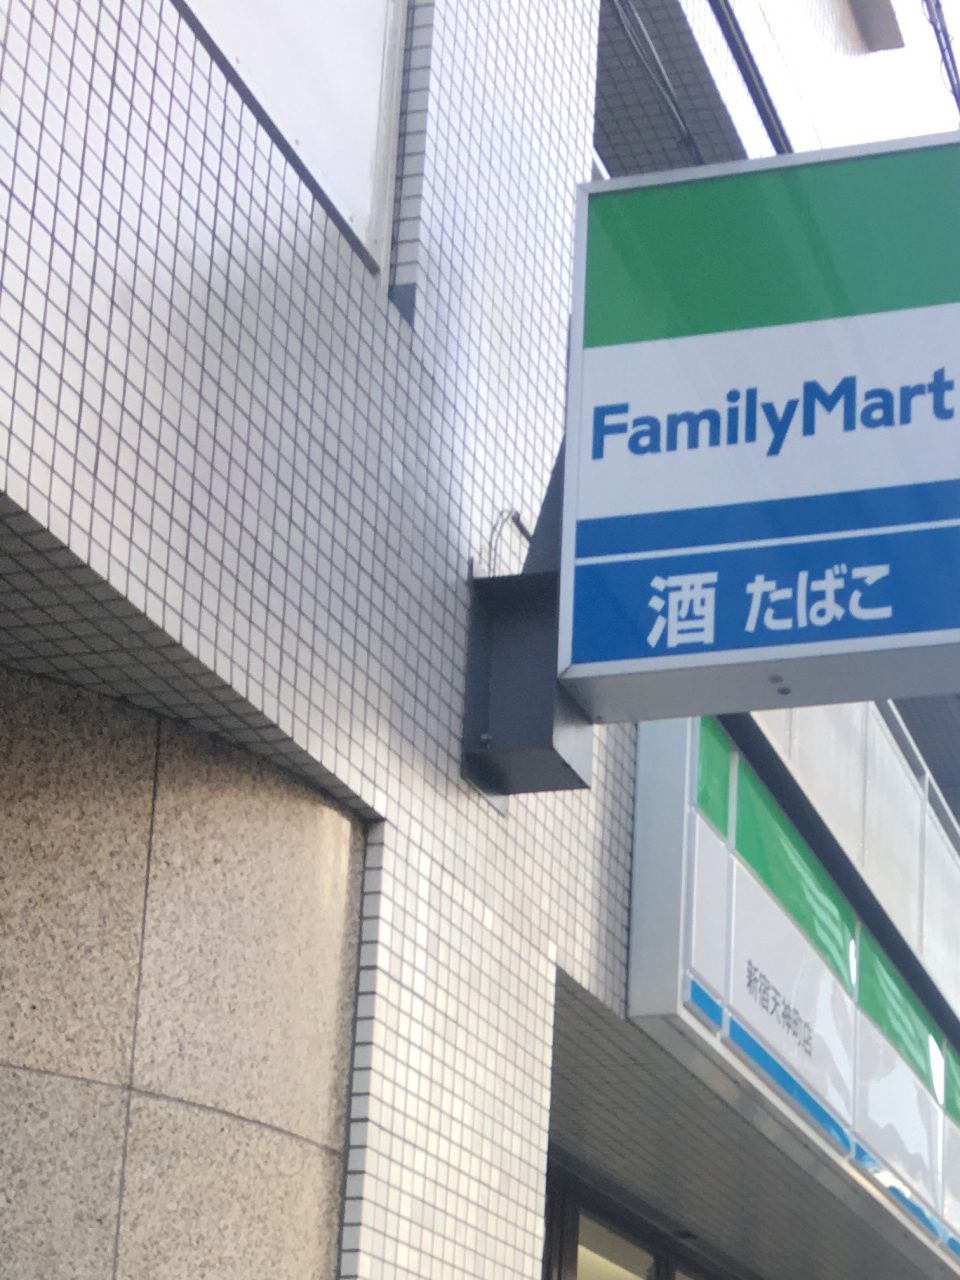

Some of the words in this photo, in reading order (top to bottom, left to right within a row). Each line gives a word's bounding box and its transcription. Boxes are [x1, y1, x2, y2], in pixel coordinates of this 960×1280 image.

[591, 366, 955, 460] FamilyMart
[646, 571, 719, 649] 酒
[744, 563, 893, 634] たばこ
